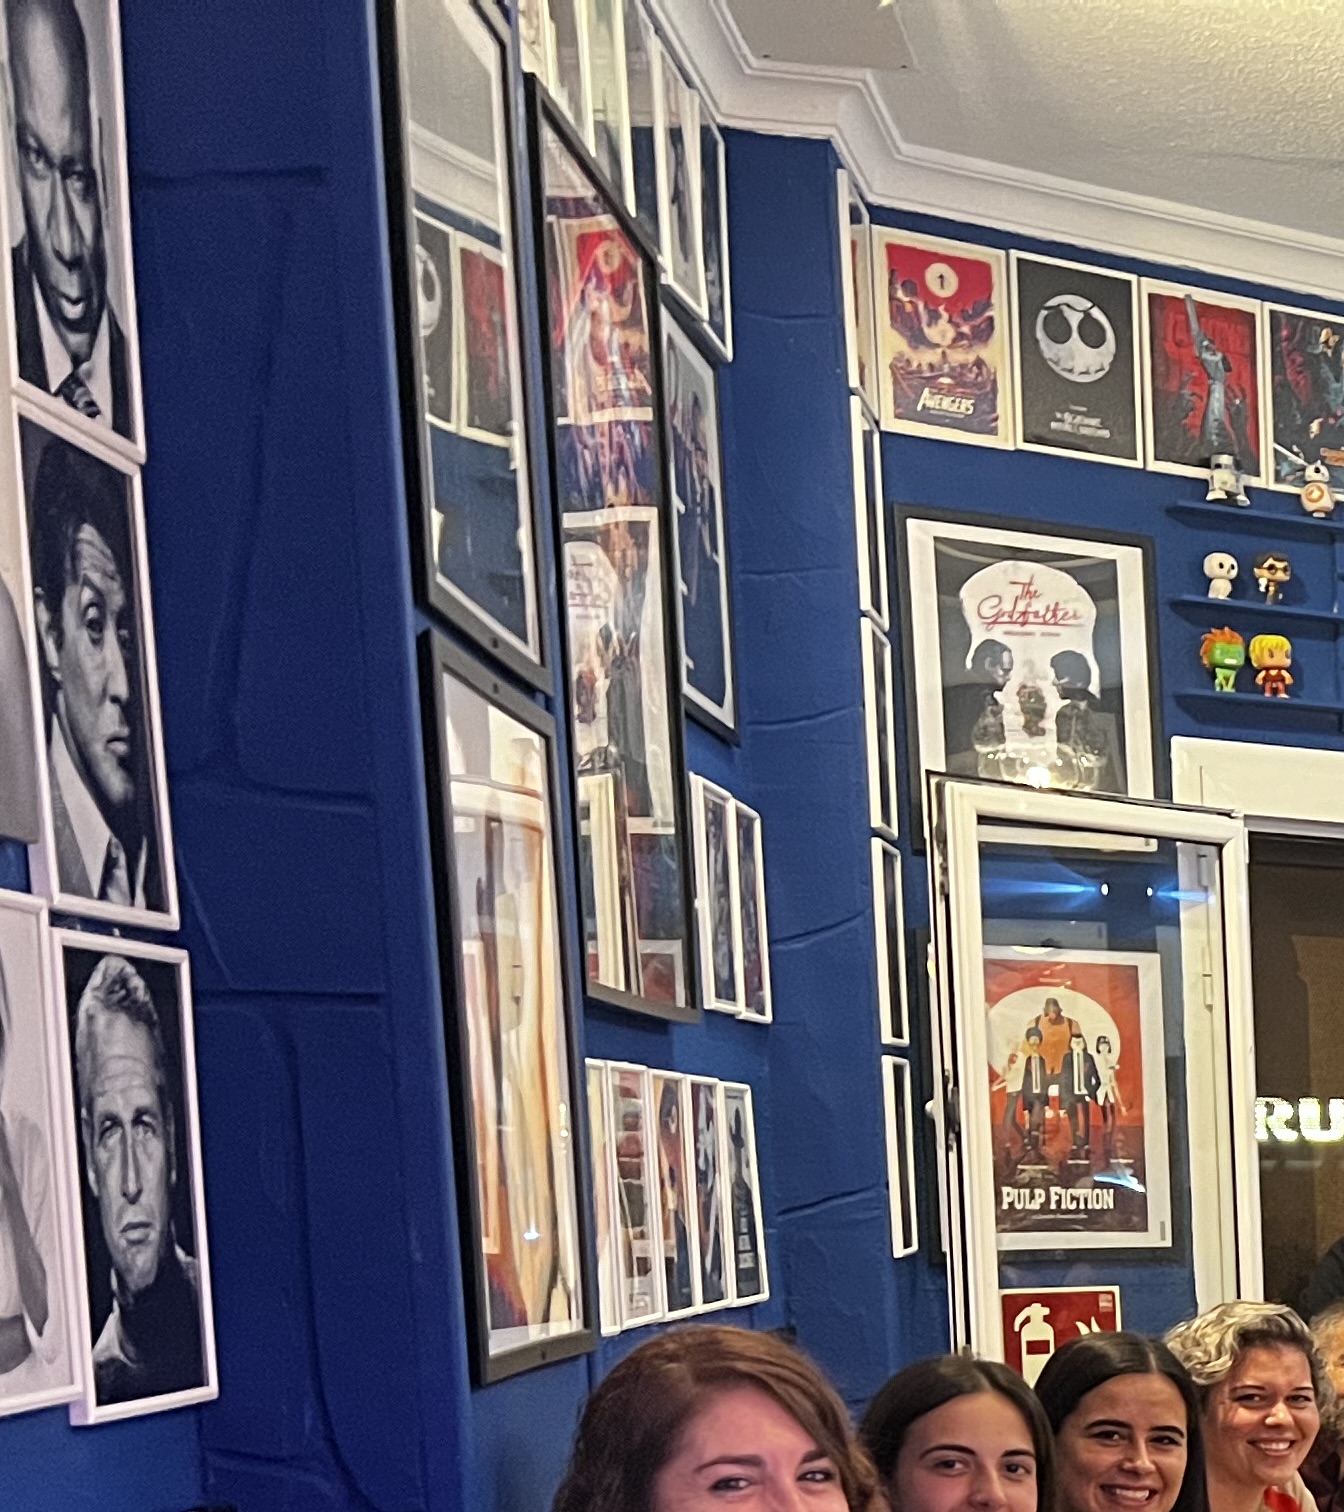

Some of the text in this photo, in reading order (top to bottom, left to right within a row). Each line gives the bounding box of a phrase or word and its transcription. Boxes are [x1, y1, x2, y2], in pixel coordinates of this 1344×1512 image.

[1009, 574, 1044, 600] The
[977, 595, 1083, 632] Godfather
[1001, 1186, 1115, 1210] PULP FICTION
